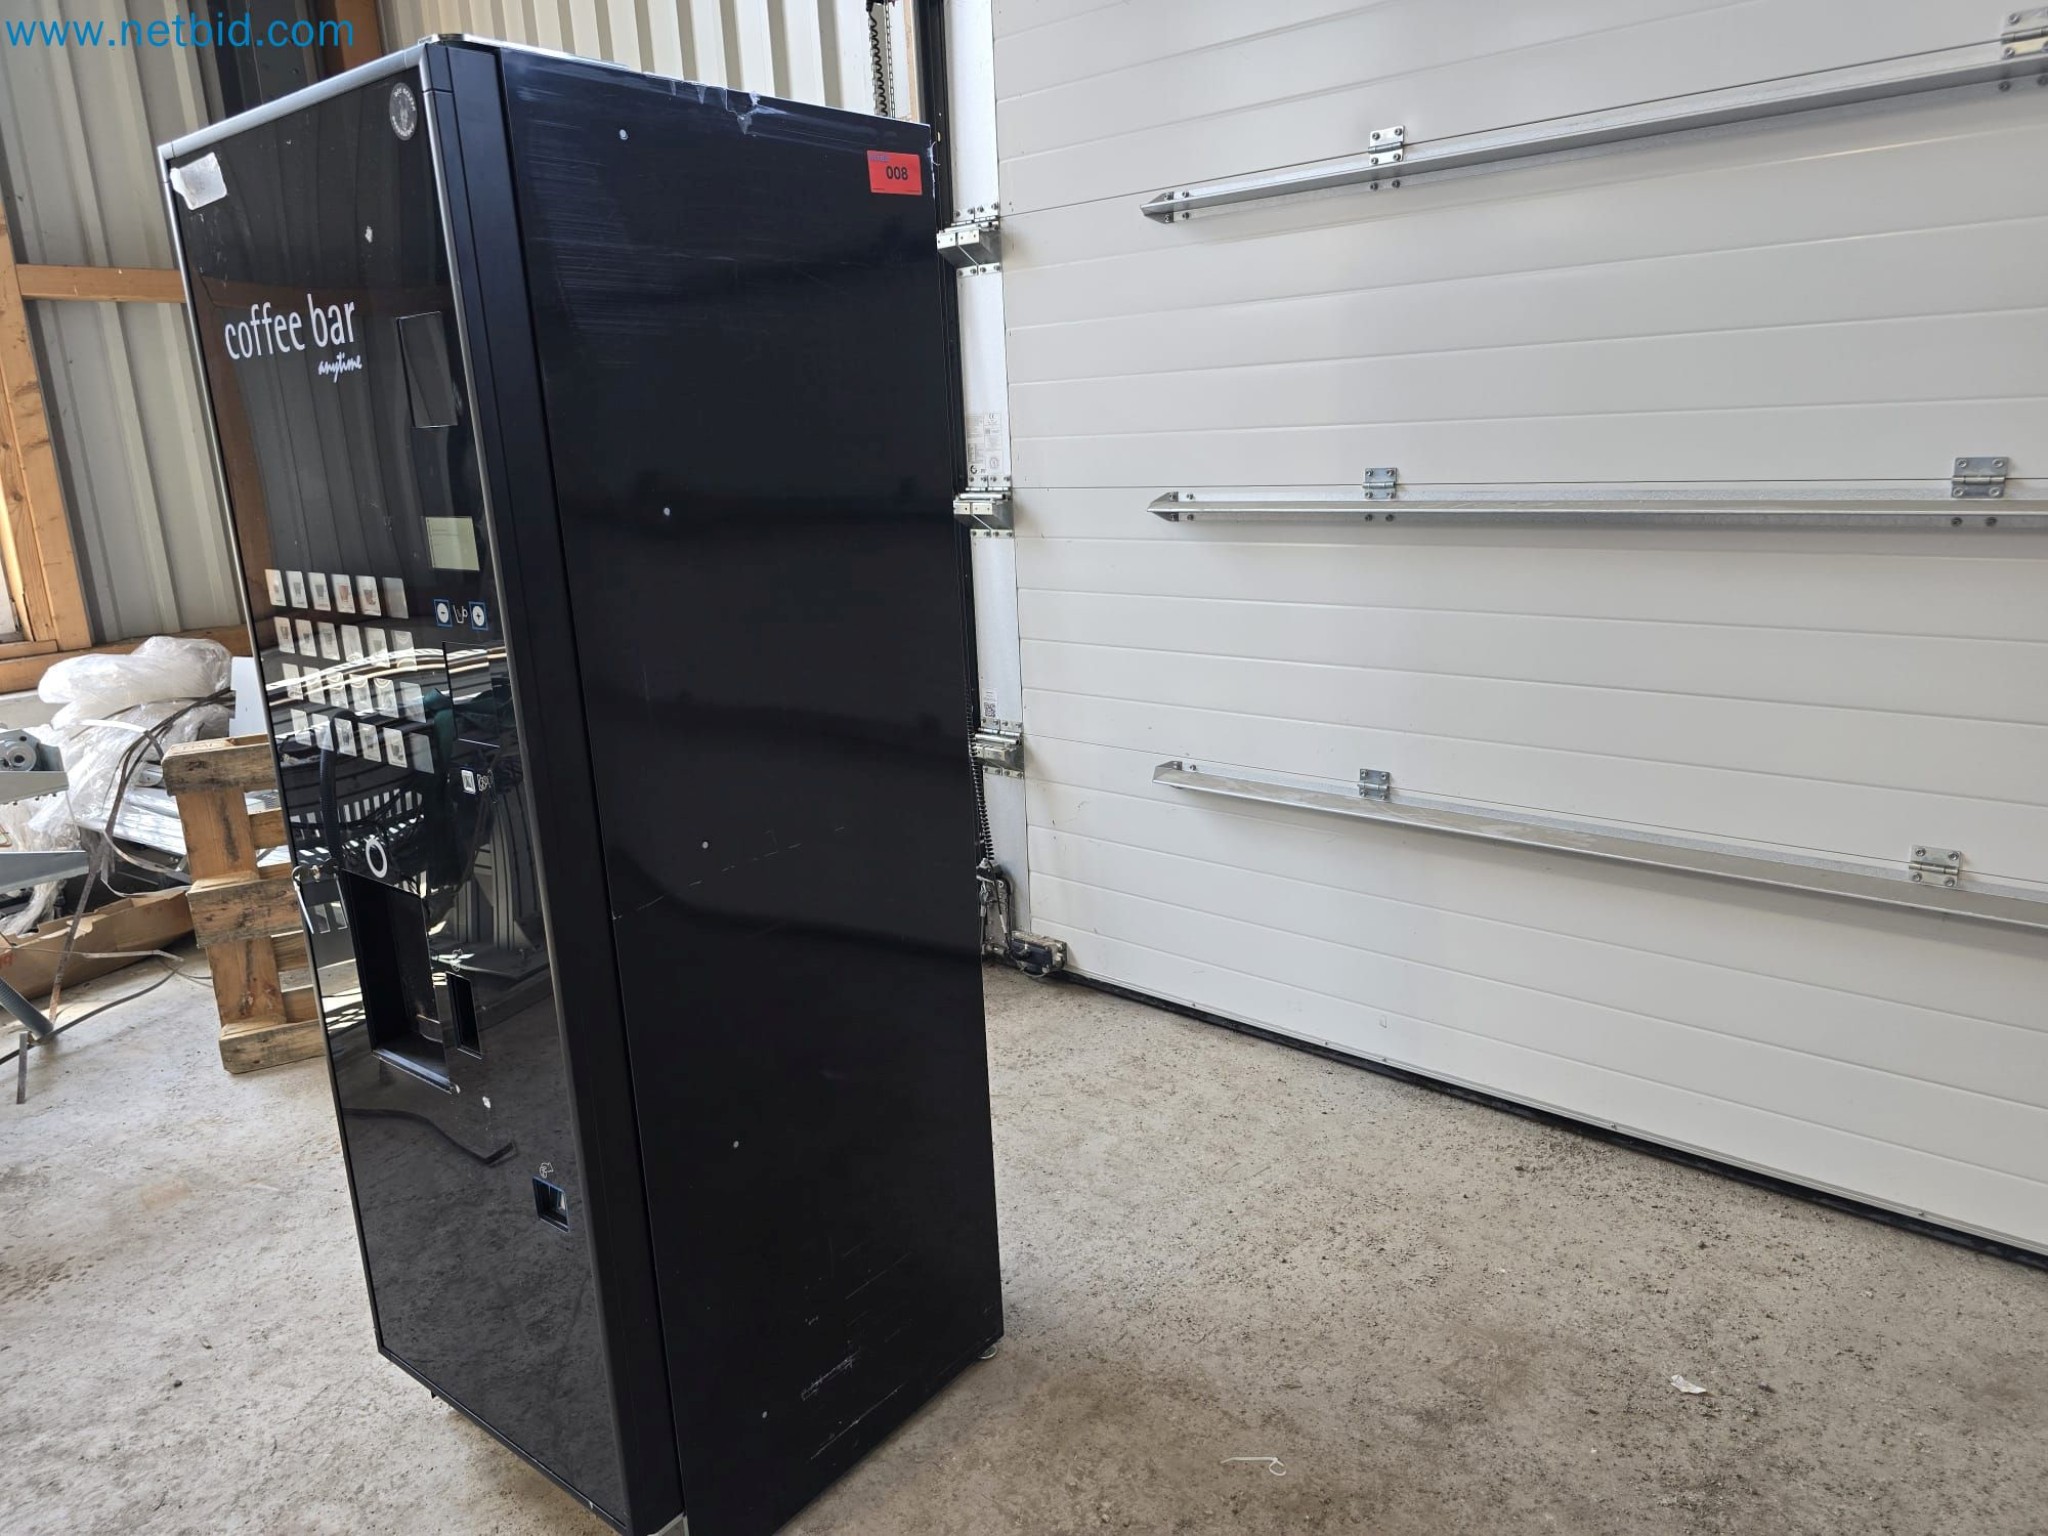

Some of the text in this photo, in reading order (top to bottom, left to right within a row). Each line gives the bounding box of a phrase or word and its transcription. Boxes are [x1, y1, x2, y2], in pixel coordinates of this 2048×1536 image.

[886, 166, 908, 180] 008
[224, 293, 355, 360] coffee bar
[318, 352, 362, 383] anytime
